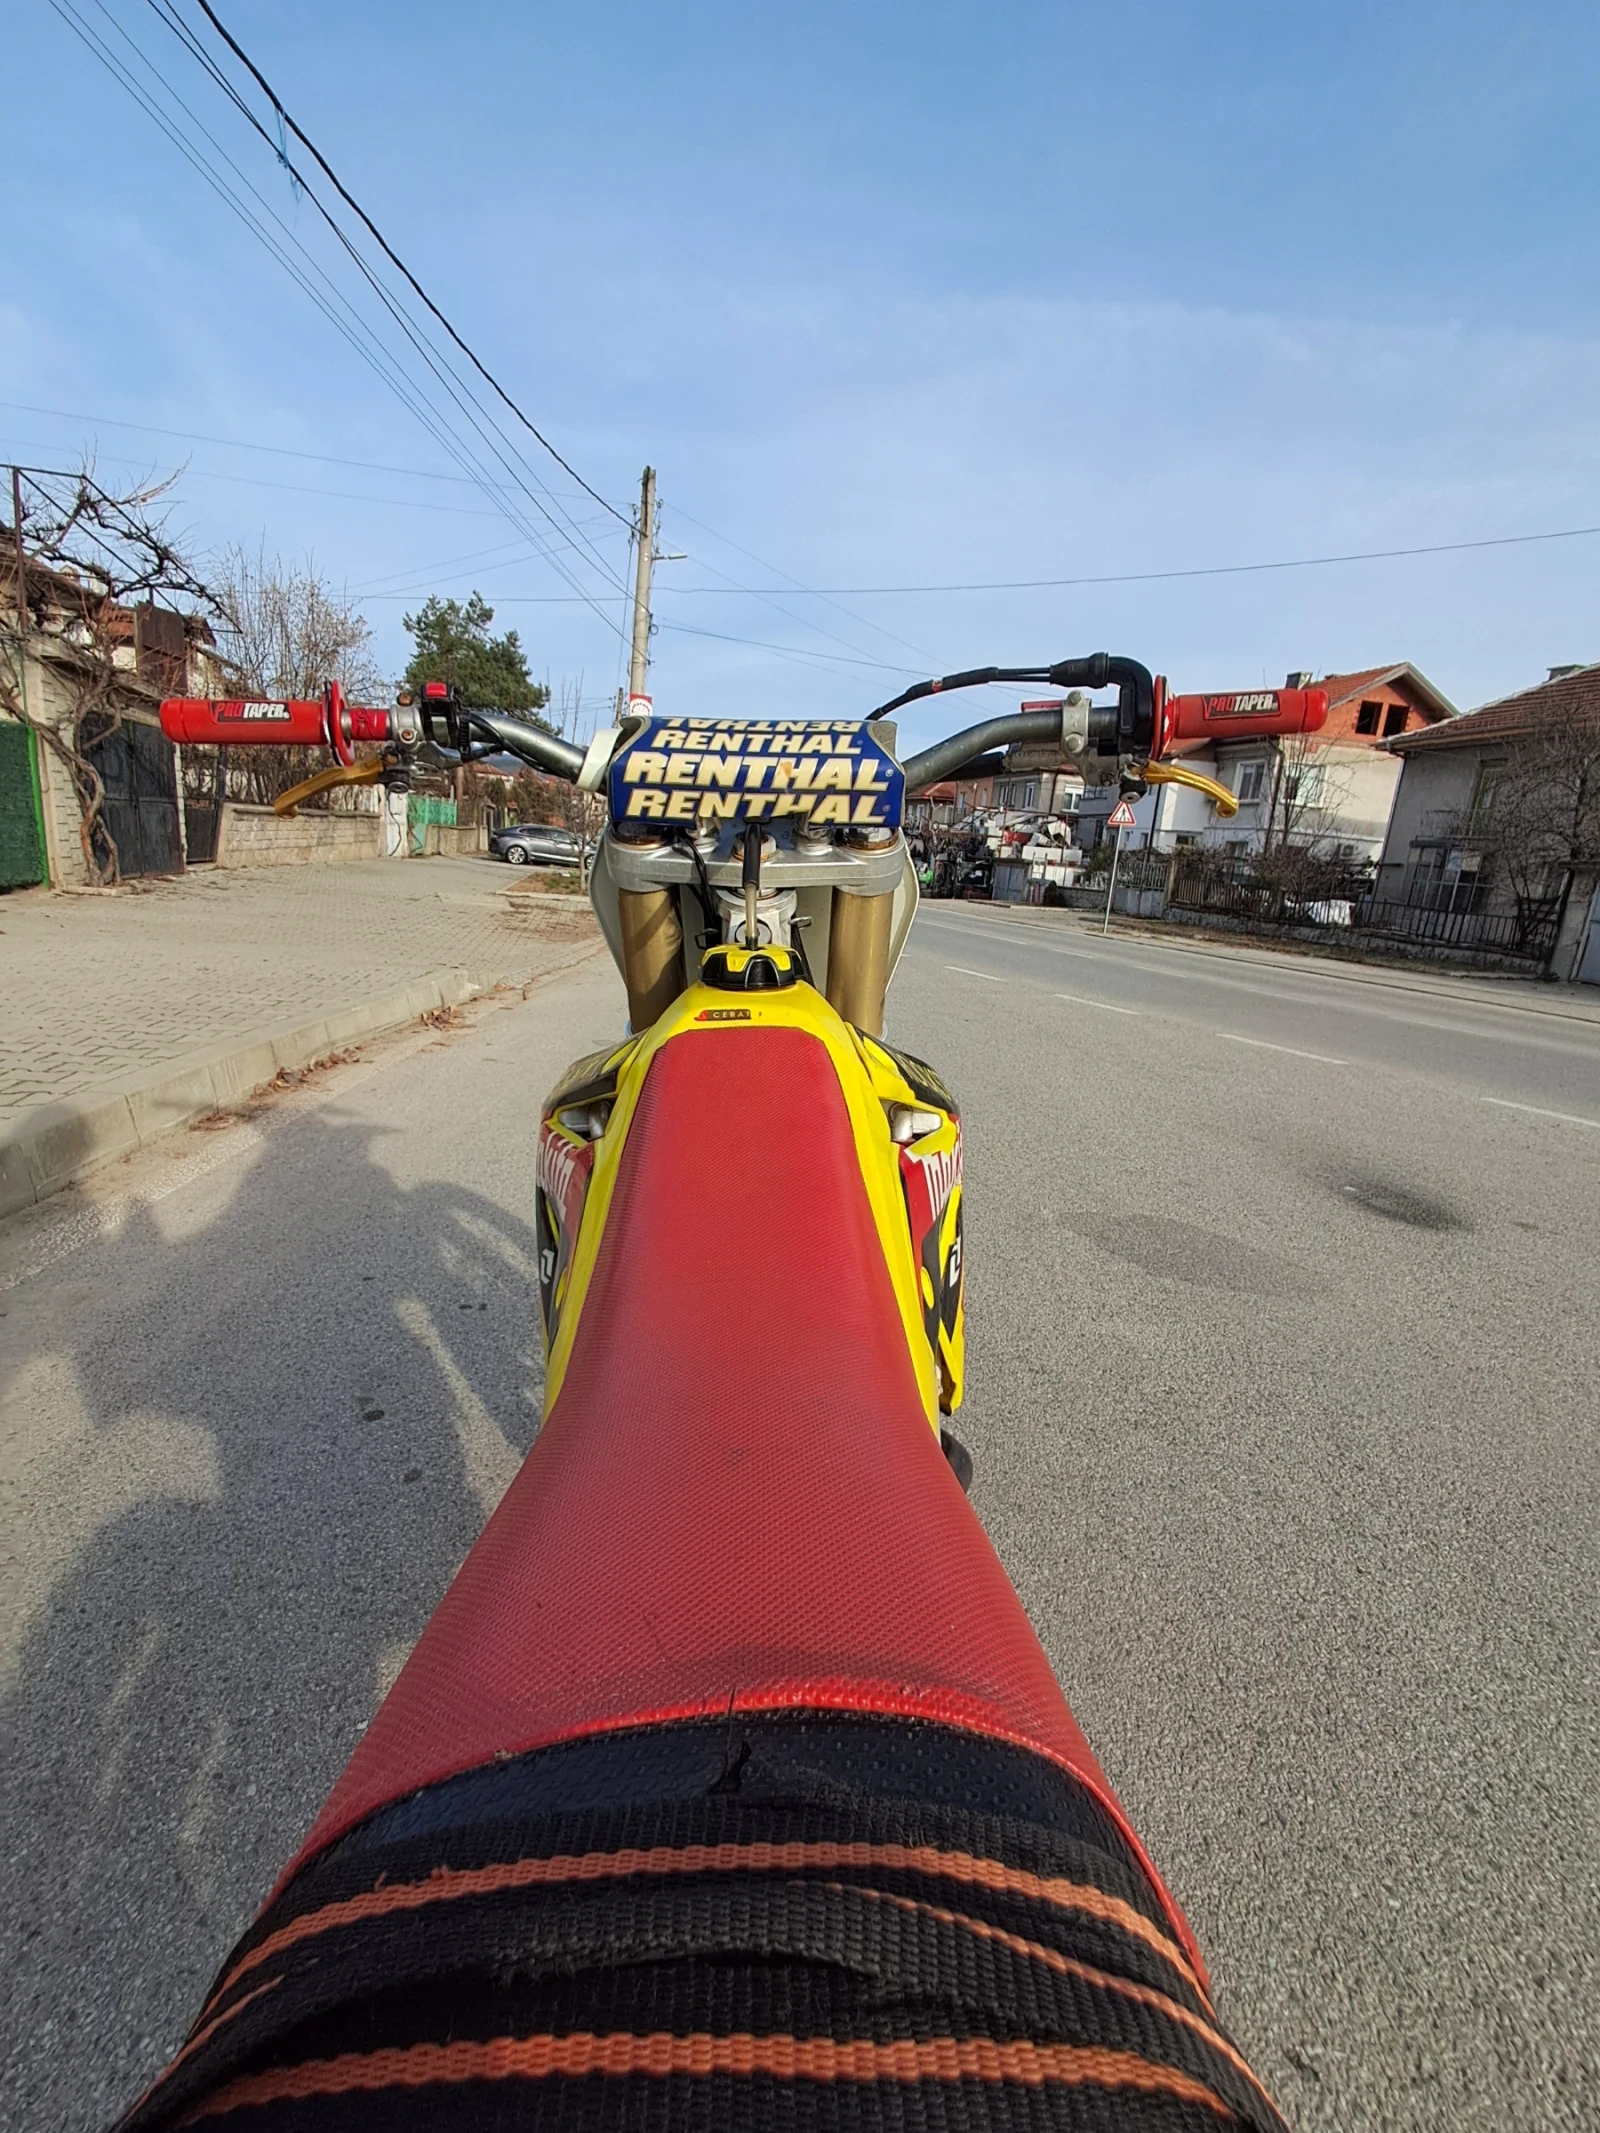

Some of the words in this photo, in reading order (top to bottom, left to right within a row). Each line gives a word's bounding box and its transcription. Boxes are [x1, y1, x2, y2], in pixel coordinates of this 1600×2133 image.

[651, 729, 863, 754] RENTHAL
[623, 751, 889, 791] RENTHAL
[625, 788, 886, 824] RENTHAL
